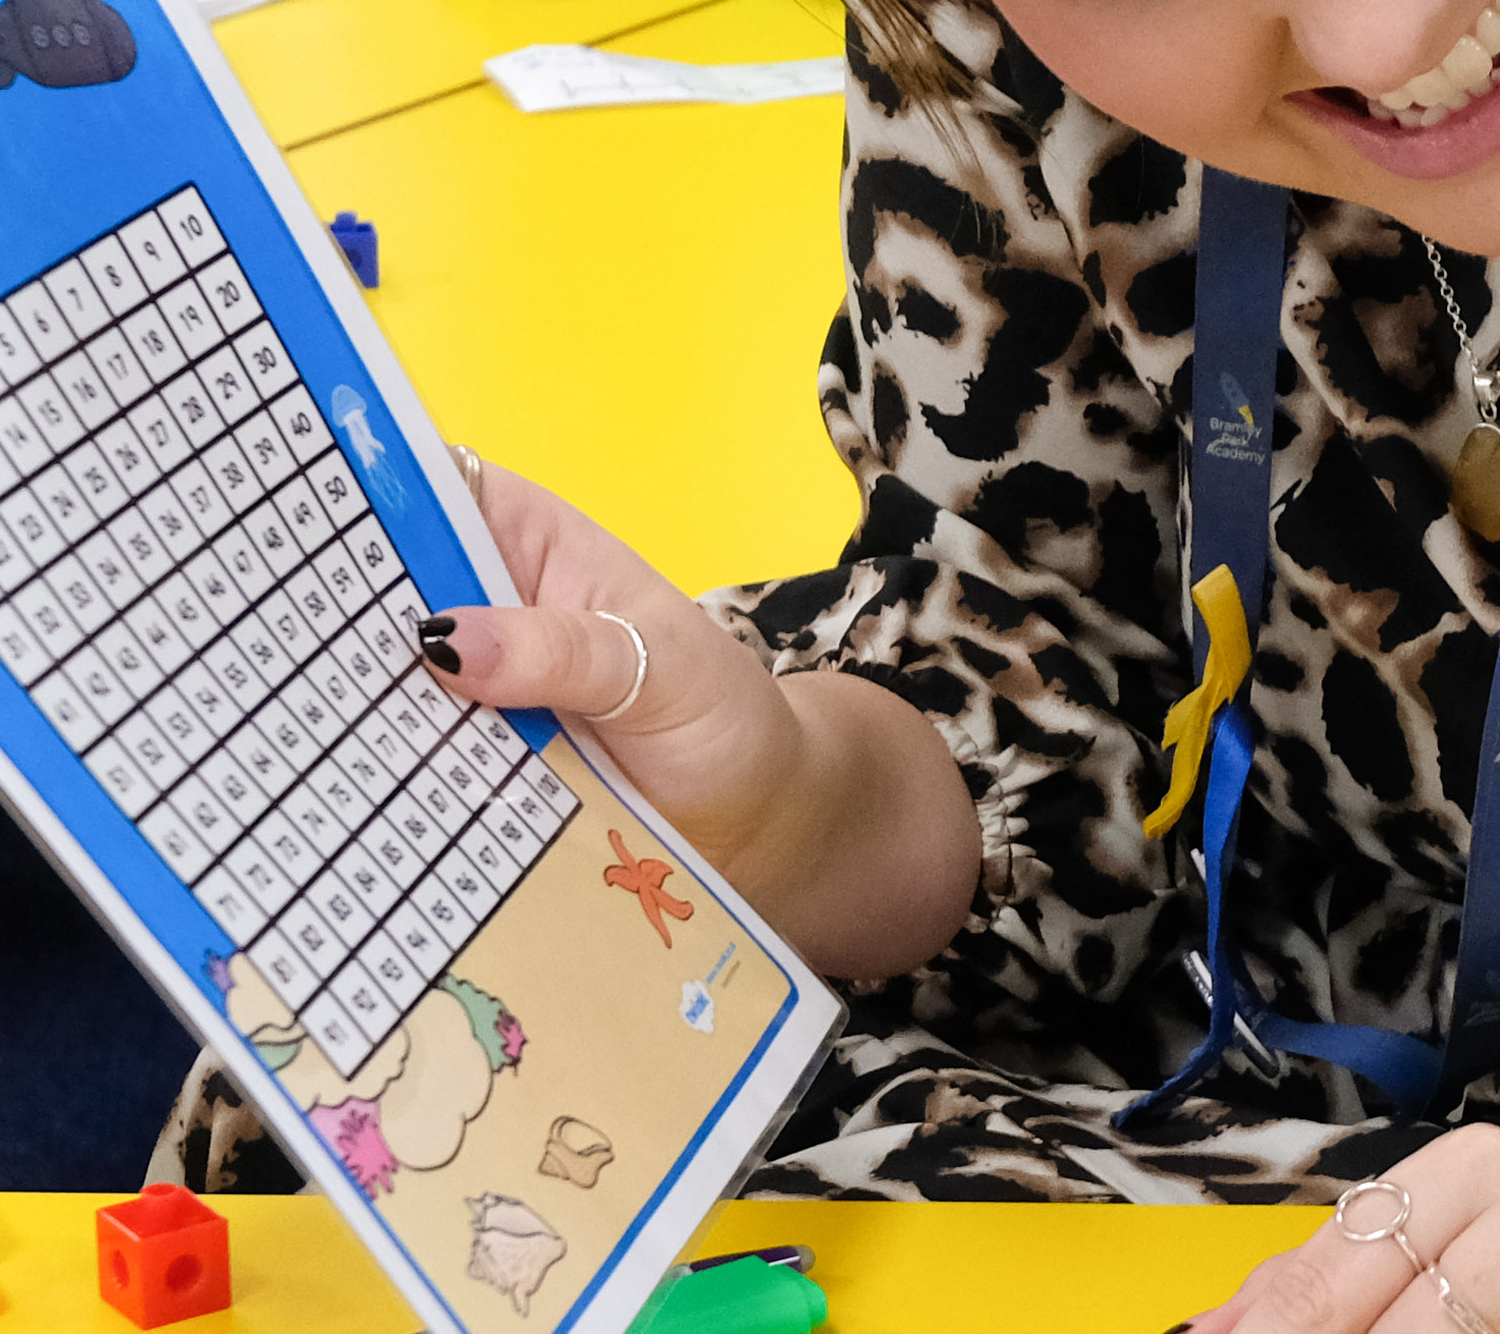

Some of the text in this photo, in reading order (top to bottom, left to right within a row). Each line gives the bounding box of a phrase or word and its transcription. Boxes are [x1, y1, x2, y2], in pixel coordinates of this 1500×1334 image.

[34, 311, 50, 334] 6
[67, 287, 83, 311] 7
[104, 264, 122, 288] 8
[143, 241, 161, 261] 9
[180, 214, 203, 241] 10
[252, 346, 277, 374] 30
[290, 412, 313, 438] 40
[324, 476, 348, 504] 50
[363, 540, 385, 569] 60
[488, 722, 510, 742] 90
[537, 773, 561, 798] 100
